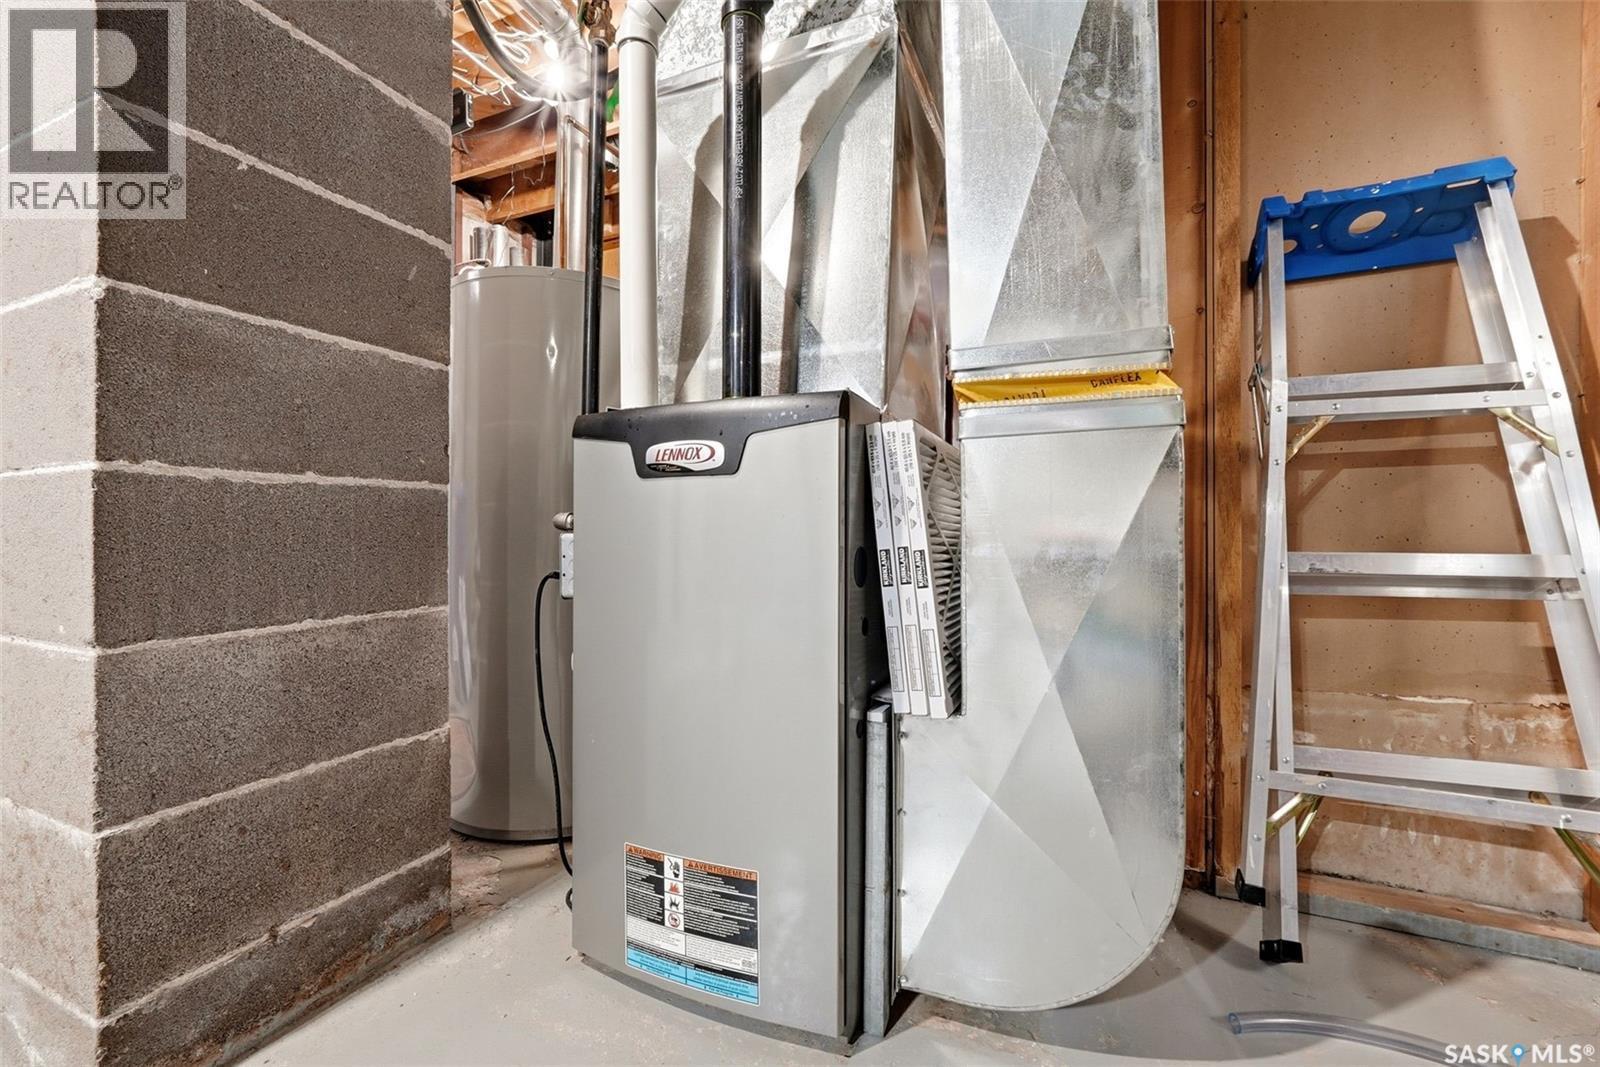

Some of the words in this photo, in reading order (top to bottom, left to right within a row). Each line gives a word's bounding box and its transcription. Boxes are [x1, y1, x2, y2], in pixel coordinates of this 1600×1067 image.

[735, 47, 743, 64] ASTM
[735, 106, 743, 122] CORE
[735, 123, 743, 154] CELLULAR
[735, 155, 743, 167] ABS
[735, 174, 743, 186] LLC
[735, 186, 743, 199] PSP
[1090, 372, 1142, 388] CANFLEX
[655, 446, 704, 462] LENNOX
[880, 550, 889, 586] KIRKLAND
[899, 548, 908, 583] KIRKLAND
[914, 551, 924, 587] KIRKLAND
[695, 863, 752, 879] AVERTISSEMENT
